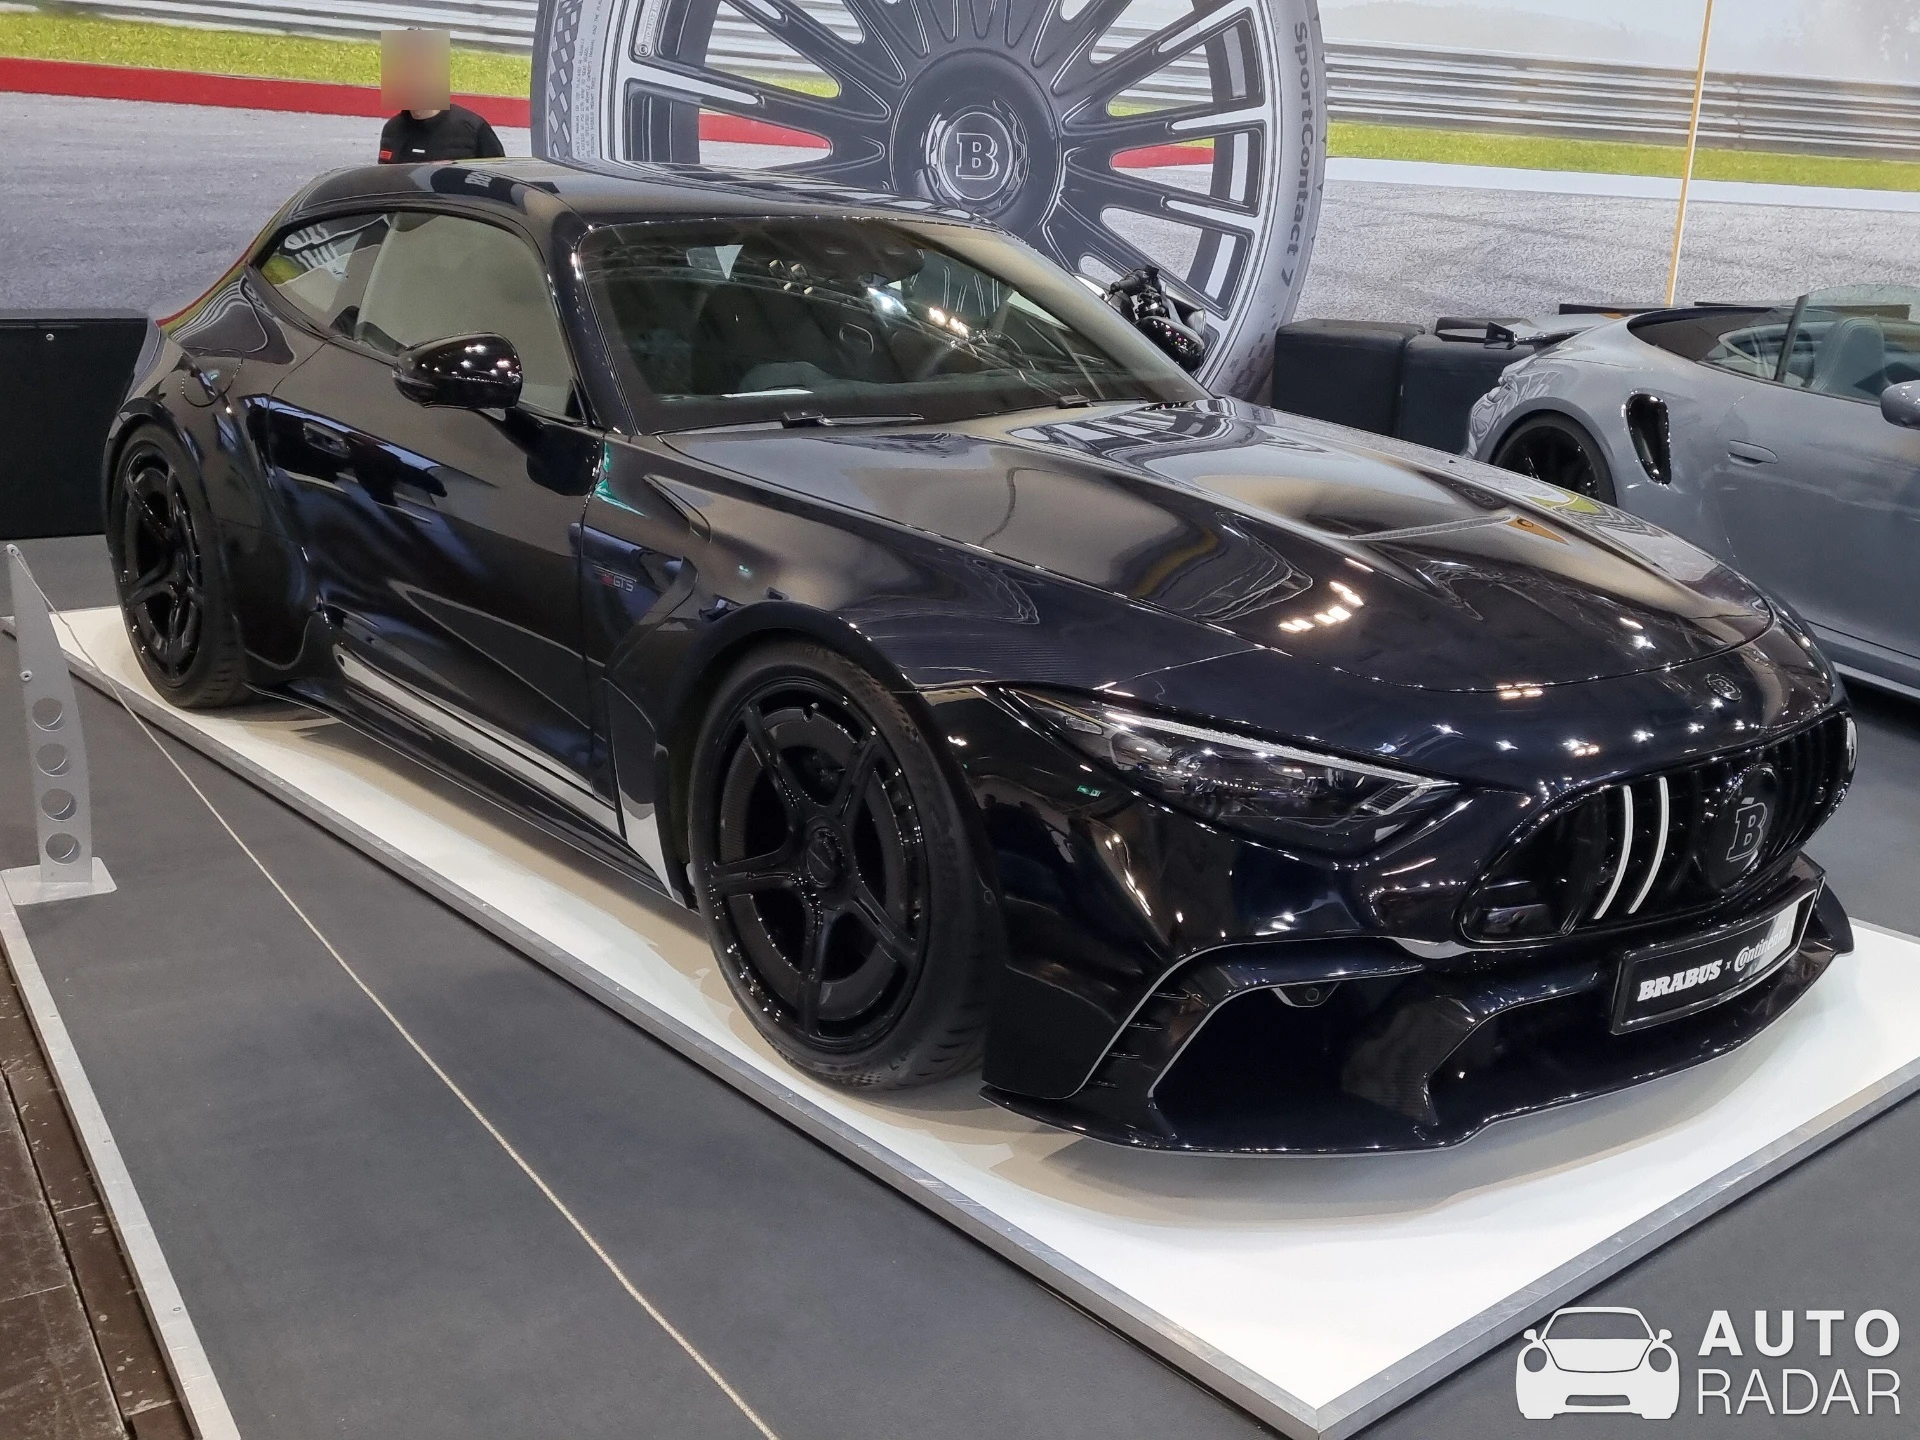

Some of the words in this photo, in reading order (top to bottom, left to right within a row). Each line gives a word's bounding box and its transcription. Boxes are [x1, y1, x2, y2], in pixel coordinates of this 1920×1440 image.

[955, 132, 999, 180] B
[1287, 21, 1313, 256] SportContact
[1281, 267, 1294, 287] 7
[613, 573, 634, 592] GTS
[1726, 802, 1768, 863] B
[1637, 959, 1723, 1002] BRABUS
[1734, 921, 1791, 972] Continental
